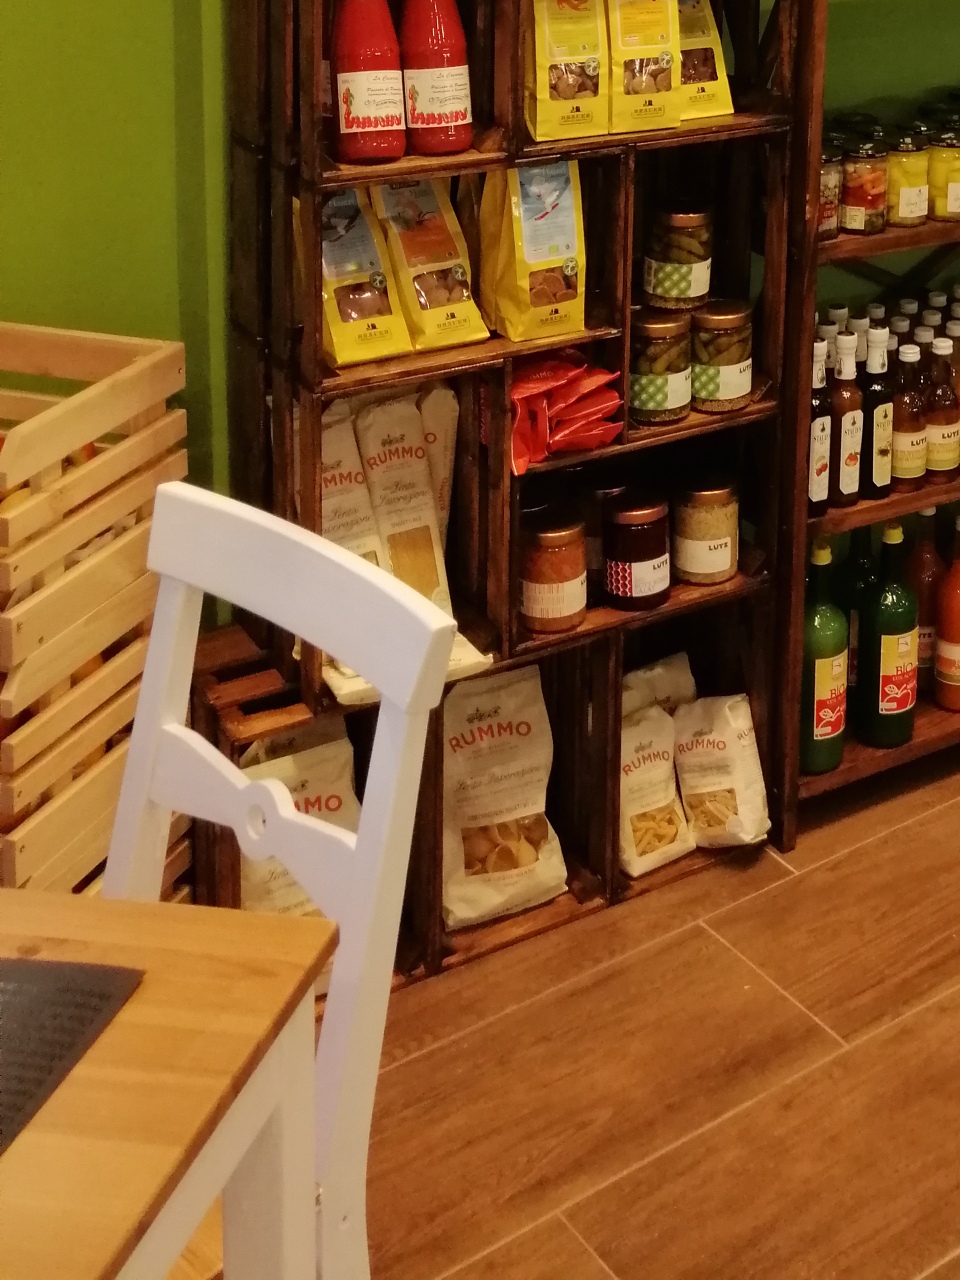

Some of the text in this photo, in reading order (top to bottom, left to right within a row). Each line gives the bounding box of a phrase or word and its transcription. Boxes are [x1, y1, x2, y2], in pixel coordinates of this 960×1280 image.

[529, 370, 554, 379] MMO
[367, 446, 426, 471] RUMMO
[323, 471, 366, 488] MMO
[708, 542, 729, 552] LUTZ
[448, 720, 532, 754] RUMMO
[678, 738, 727, 755] RUMMO
[622, 750, 670, 776] RUMMO
